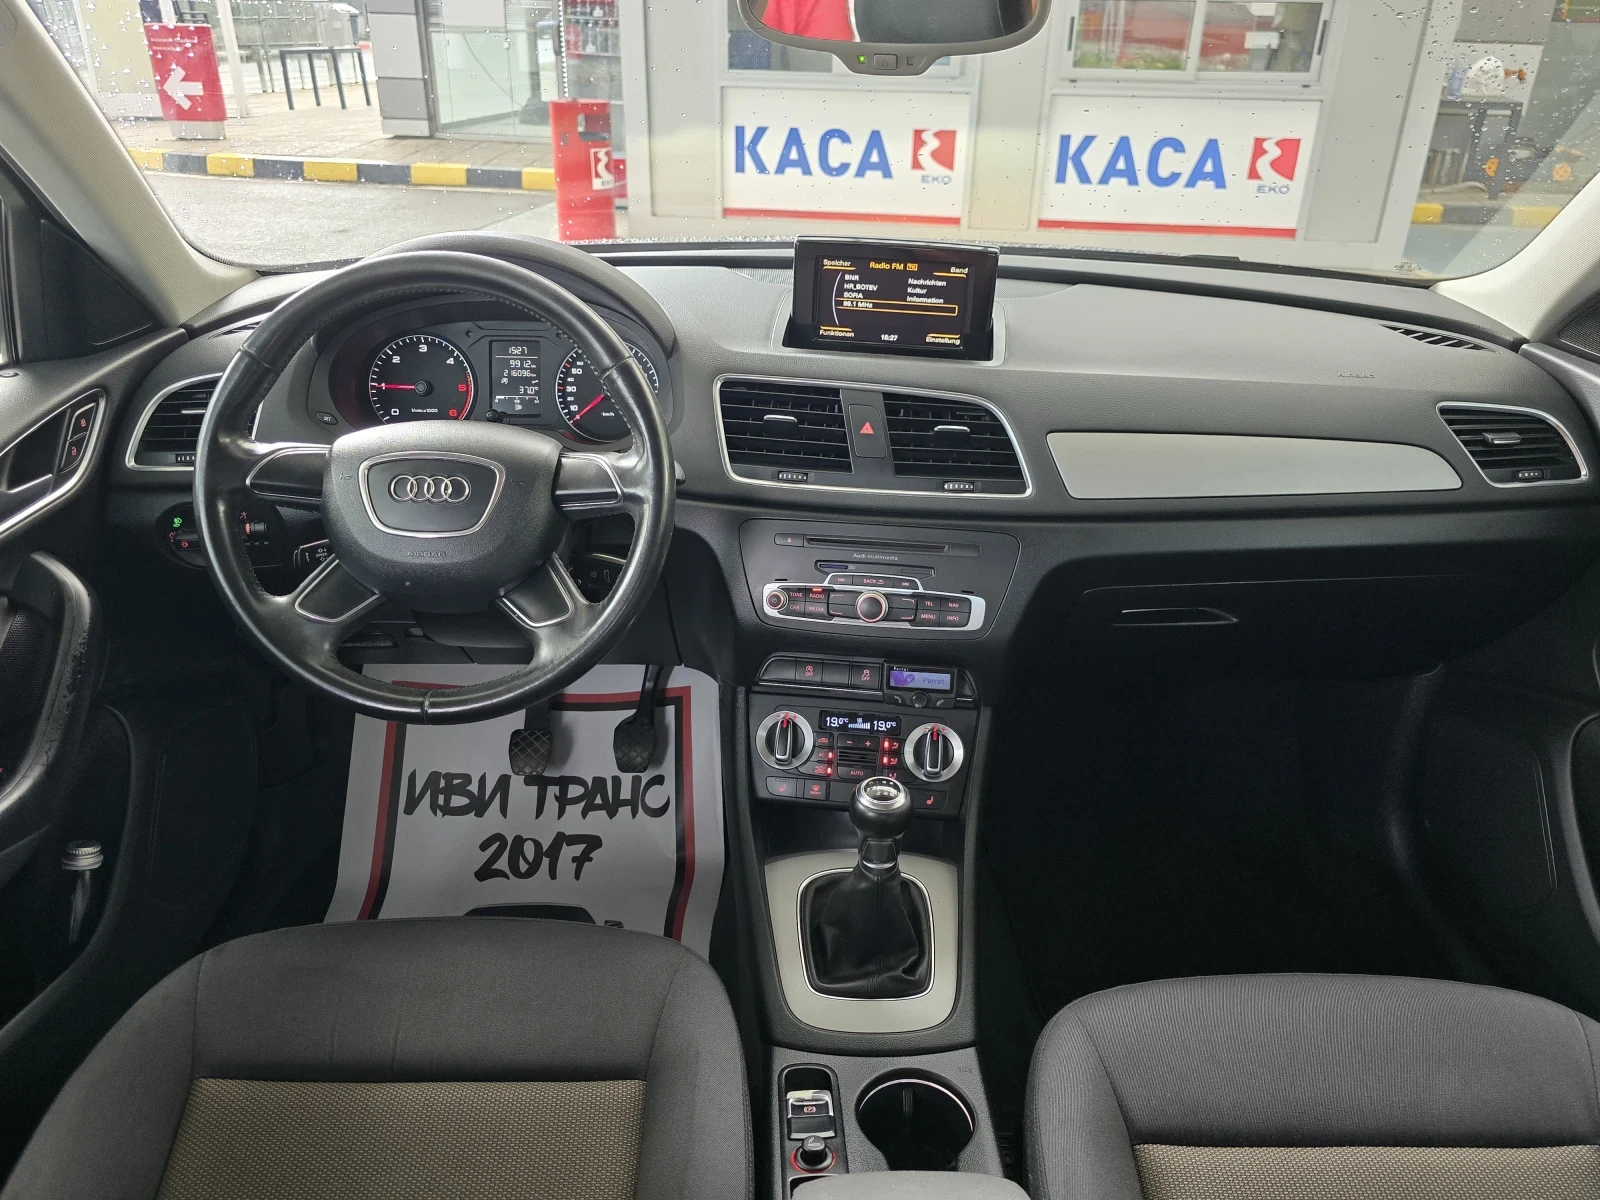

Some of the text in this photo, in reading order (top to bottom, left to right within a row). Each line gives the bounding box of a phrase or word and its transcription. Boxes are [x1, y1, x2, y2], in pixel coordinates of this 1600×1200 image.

[735, 125, 893, 179] КАСА
[1055, 134, 1227, 190] КАСА
[1256, 184, 1291, 195] EKO
[823, 259, 851, 267] Speicher
[869, 261, 904, 270] Radio FM
[950, 266, 969, 274] Band
[844, 273, 860, 281] BNR
[843, 282, 878, 291] HR_BOTEV
[907, 278, 947, 287] Nachrichten
[843, 291, 864, 299] SOFIA
[906, 295, 944, 304] Information
[819, 329, 855, 338] Funktionen
[925, 336, 961, 345] Einstellung
[418, 344, 428, 352] 3
[449, 409, 457, 417] 6
[922, 677, 945, 686] Parrot
[403, 769, 670, 821] ИВИ ТРАНС
[473, 831, 603, 883] 2017
